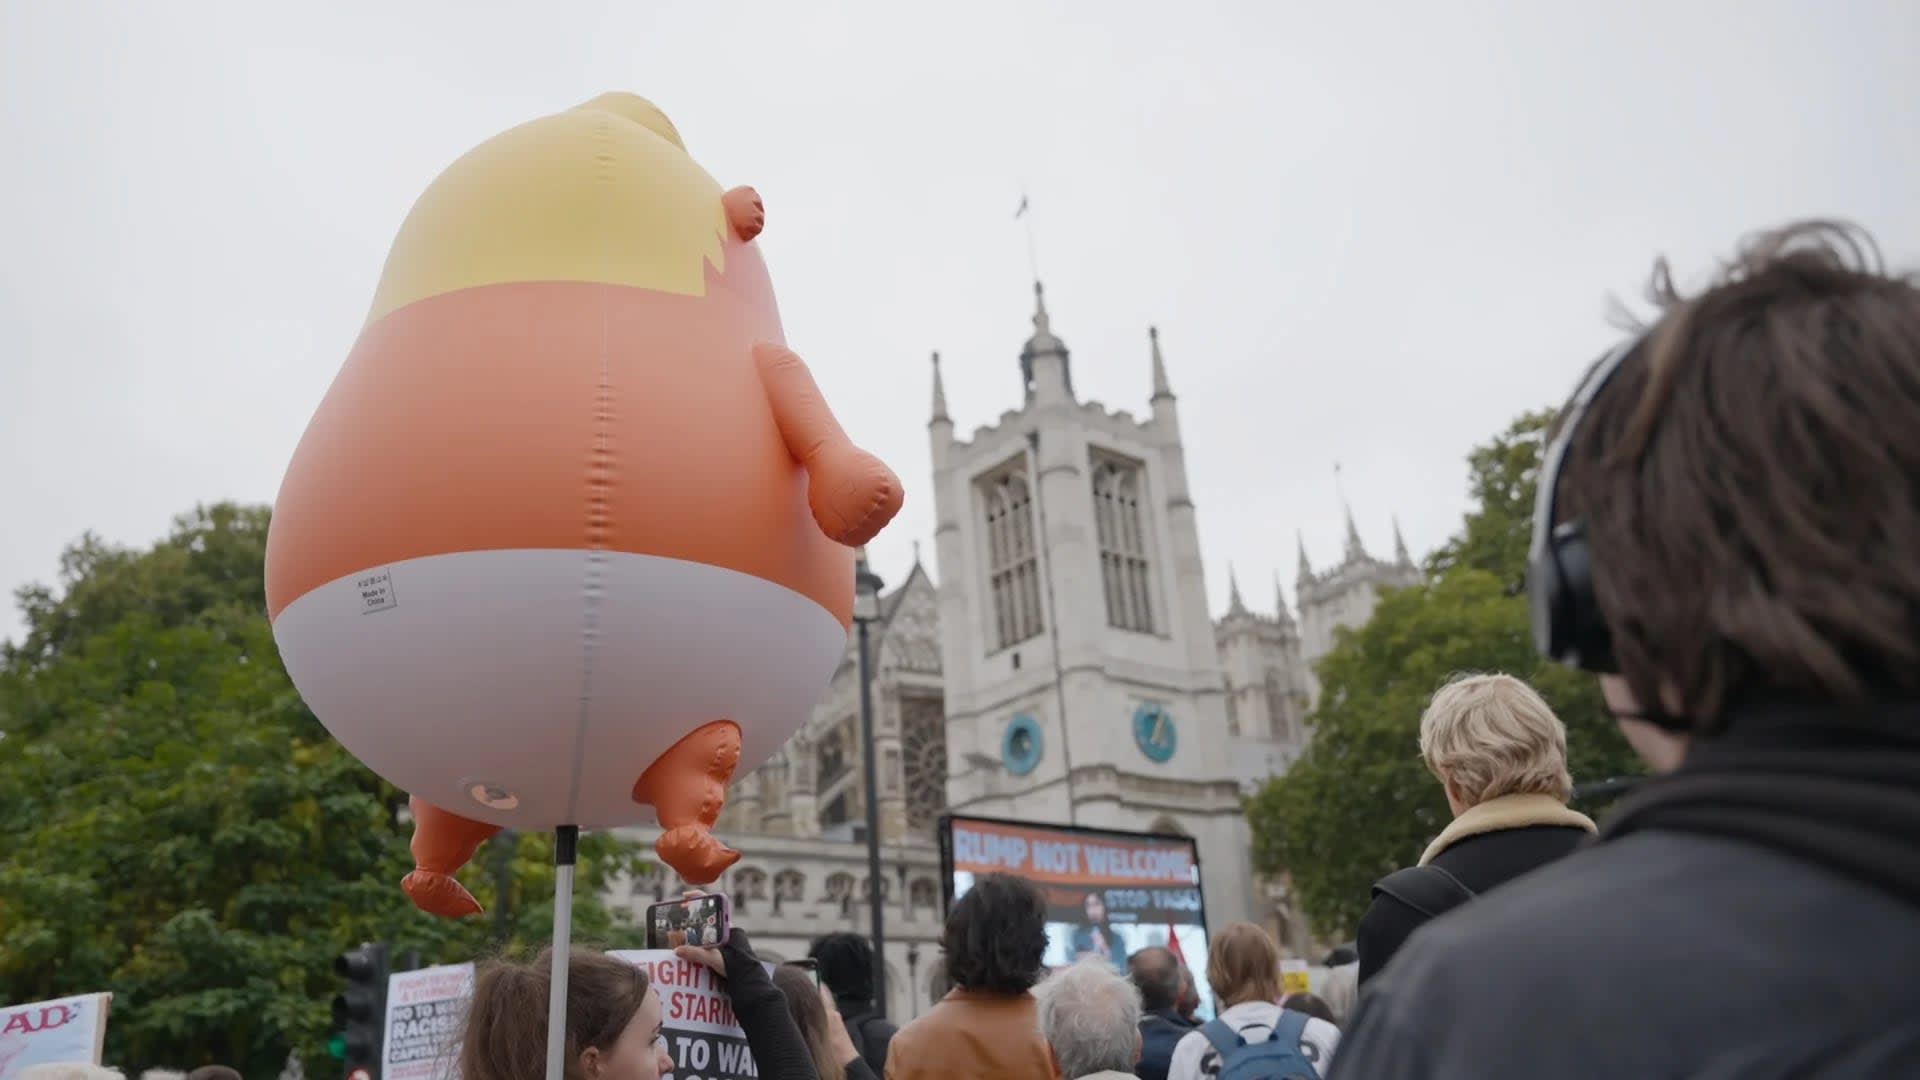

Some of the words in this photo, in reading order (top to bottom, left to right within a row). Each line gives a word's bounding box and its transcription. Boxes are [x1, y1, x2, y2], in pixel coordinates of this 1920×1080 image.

[1032, 840, 1079, 872] NOT
[633, 961, 704, 989] IGHT
[415, 1004, 433, 1018] TO
[676, 1037, 710, 1070] TO
